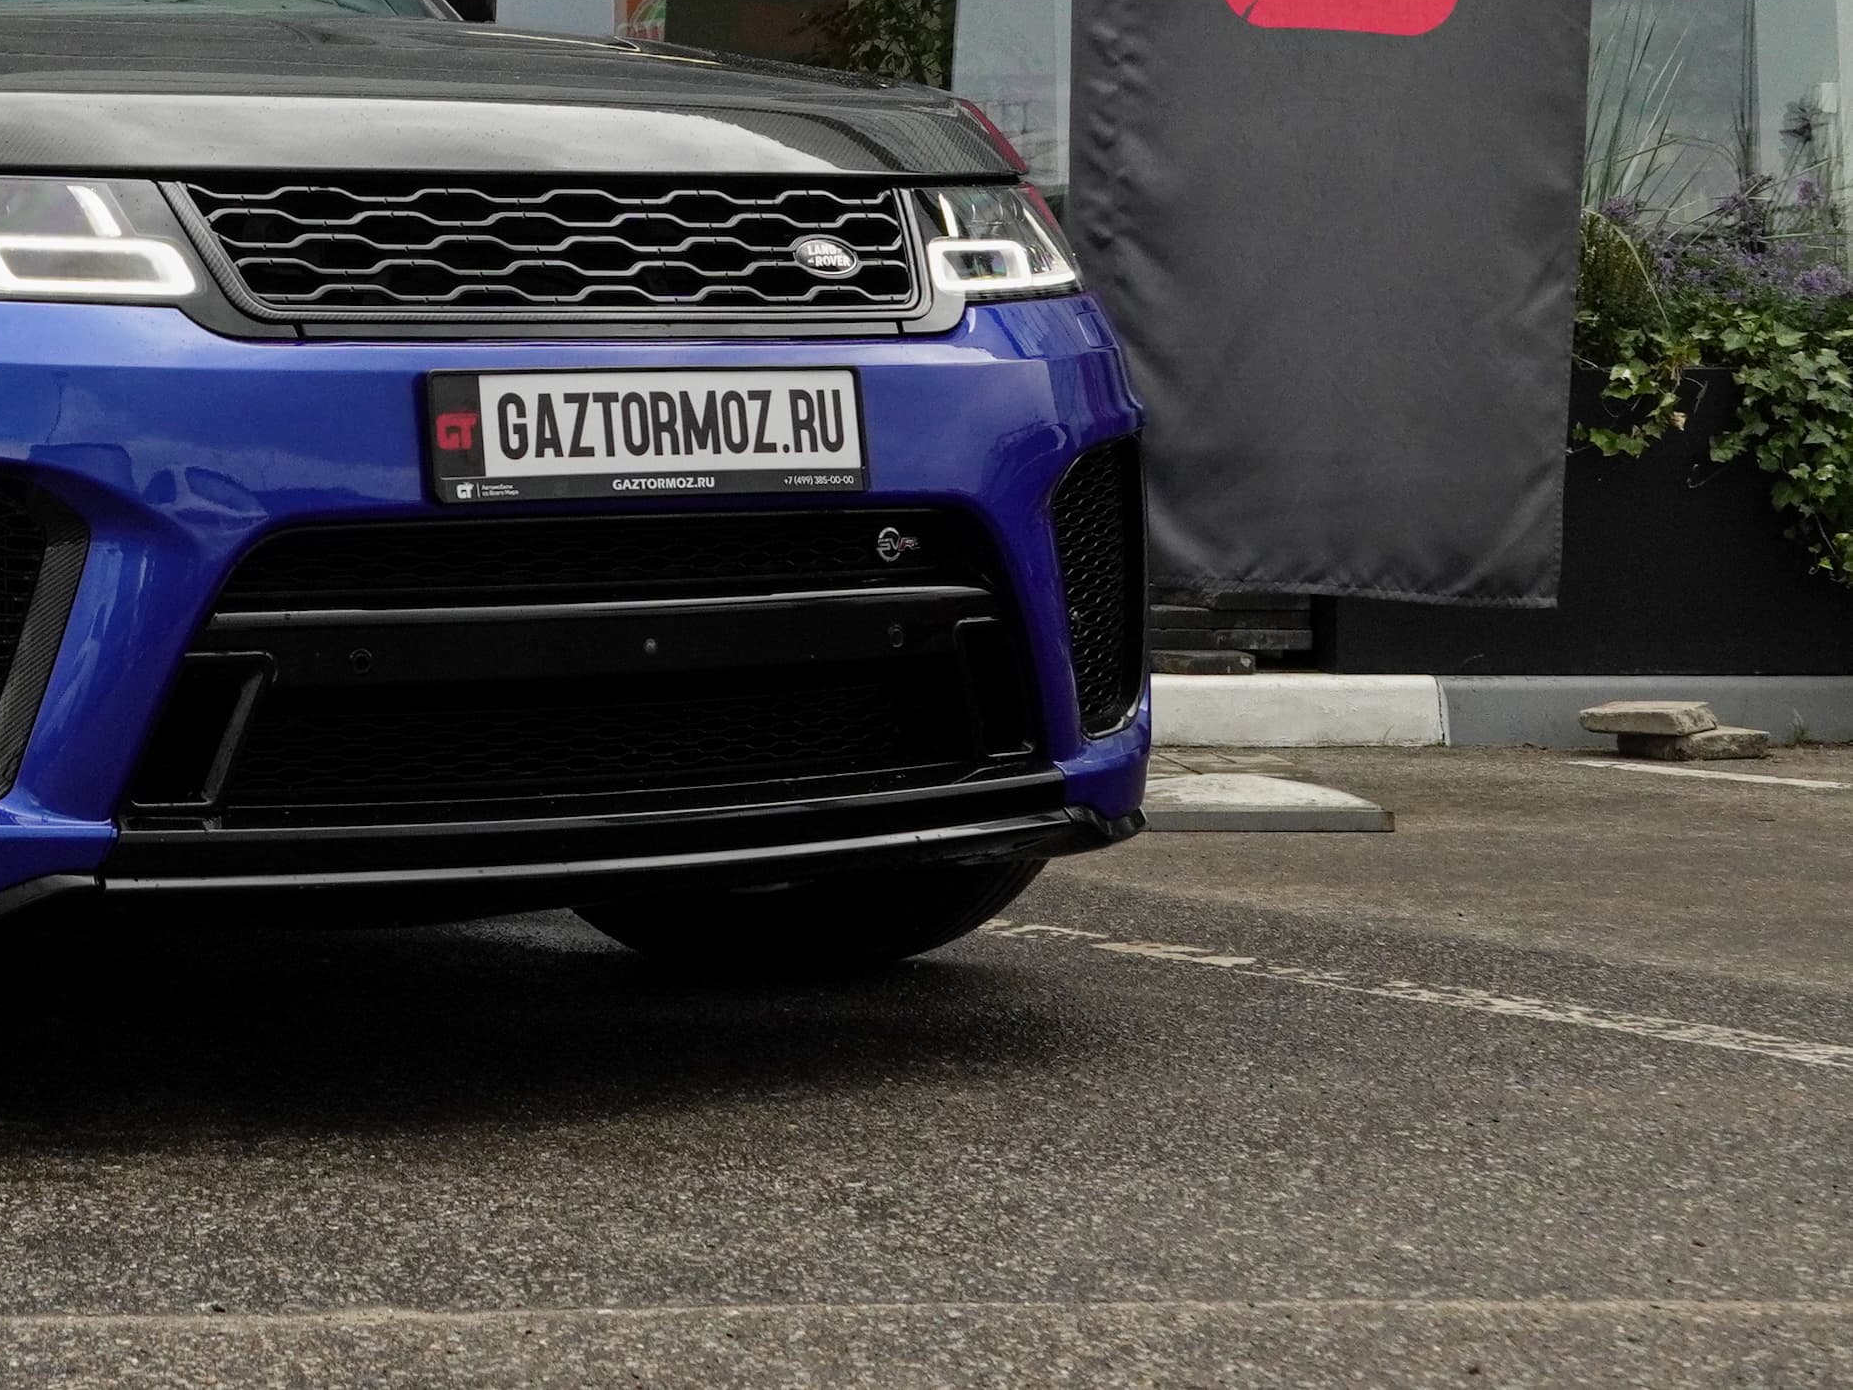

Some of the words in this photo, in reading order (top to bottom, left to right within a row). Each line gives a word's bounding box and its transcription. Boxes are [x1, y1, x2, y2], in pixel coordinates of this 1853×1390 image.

[808, 244, 837, 255] LAND
[815, 256, 850, 267] ROVER
[496, 389, 846, 461] GAZTORMOZ.RU
[612, 476, 716, 492] GAZTORMOZ.RU
